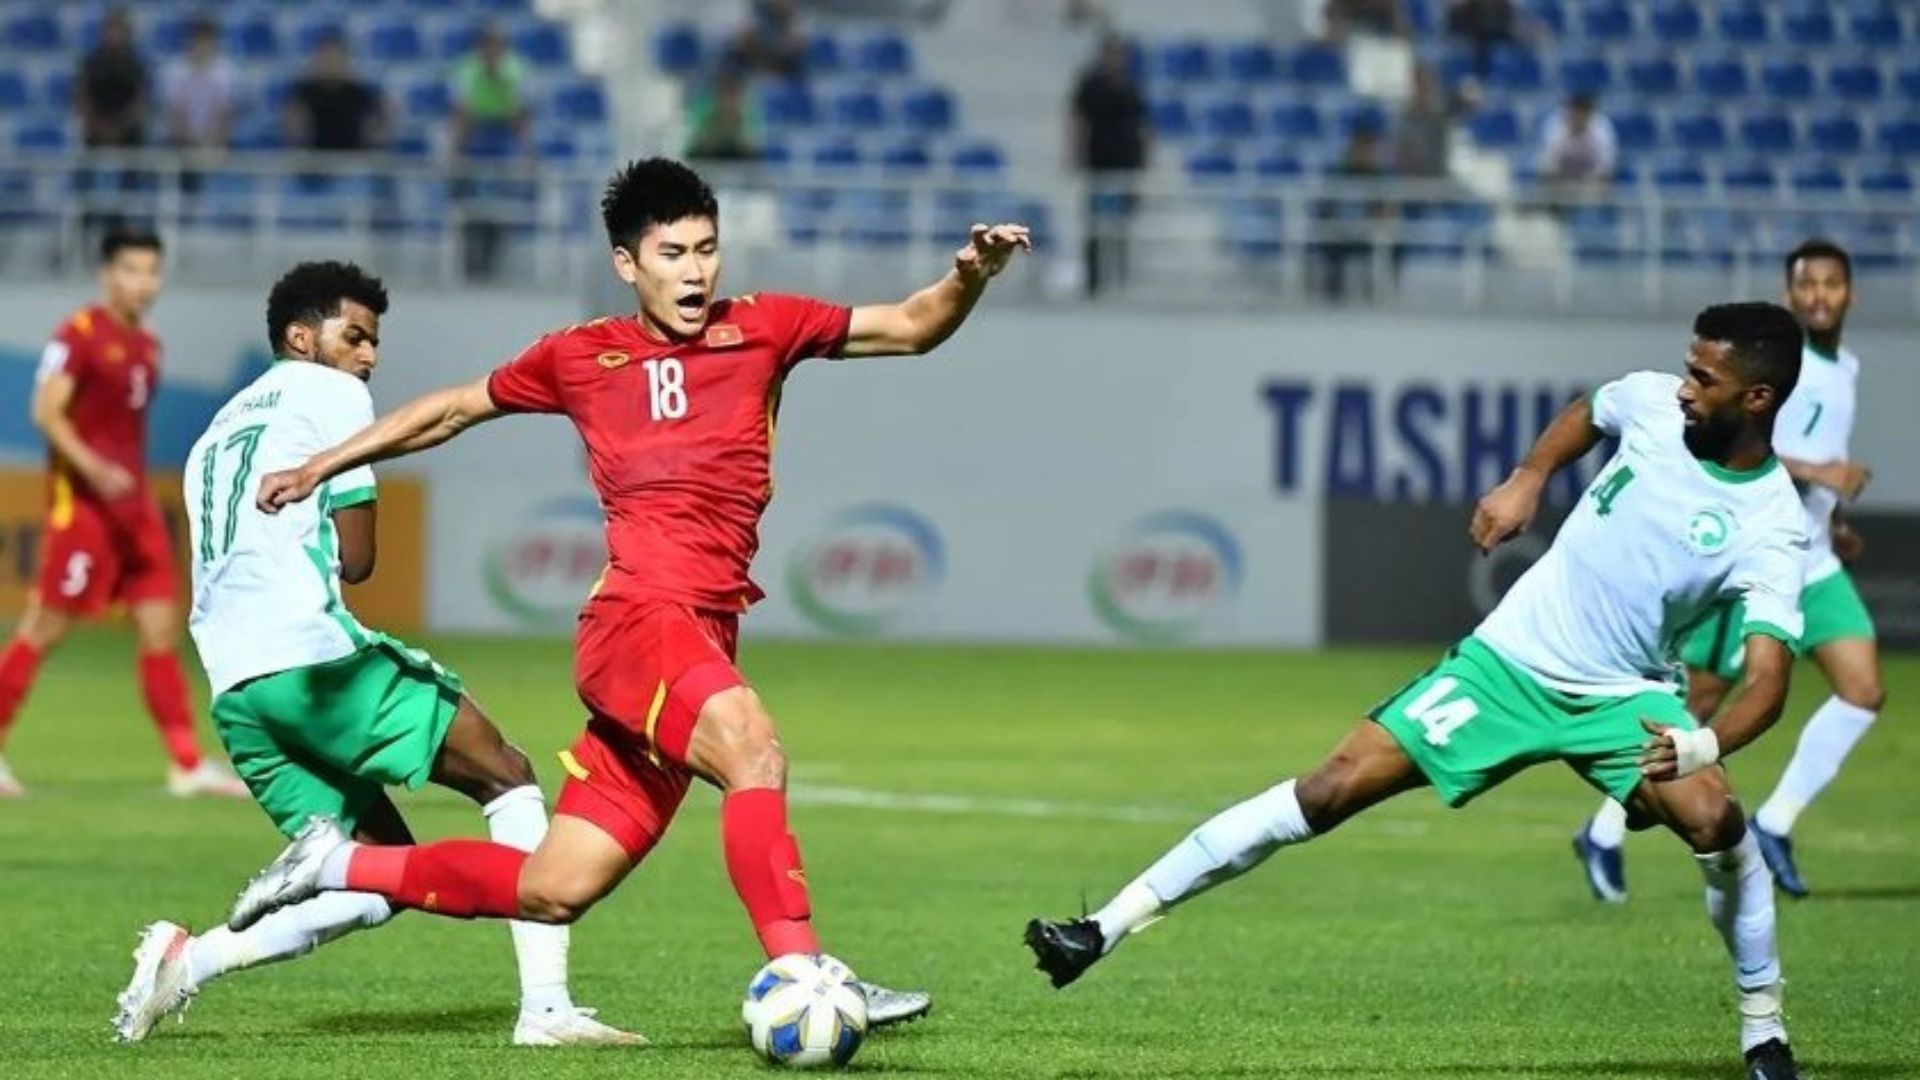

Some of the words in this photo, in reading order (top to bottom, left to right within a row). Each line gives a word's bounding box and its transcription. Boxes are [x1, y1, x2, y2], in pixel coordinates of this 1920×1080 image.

[642, 357, 688, 421] 18
[1803, 401, 1823, 438] 7
[201, 424, 268, 563] 17
[1402, 677, 1480, 746] 14
